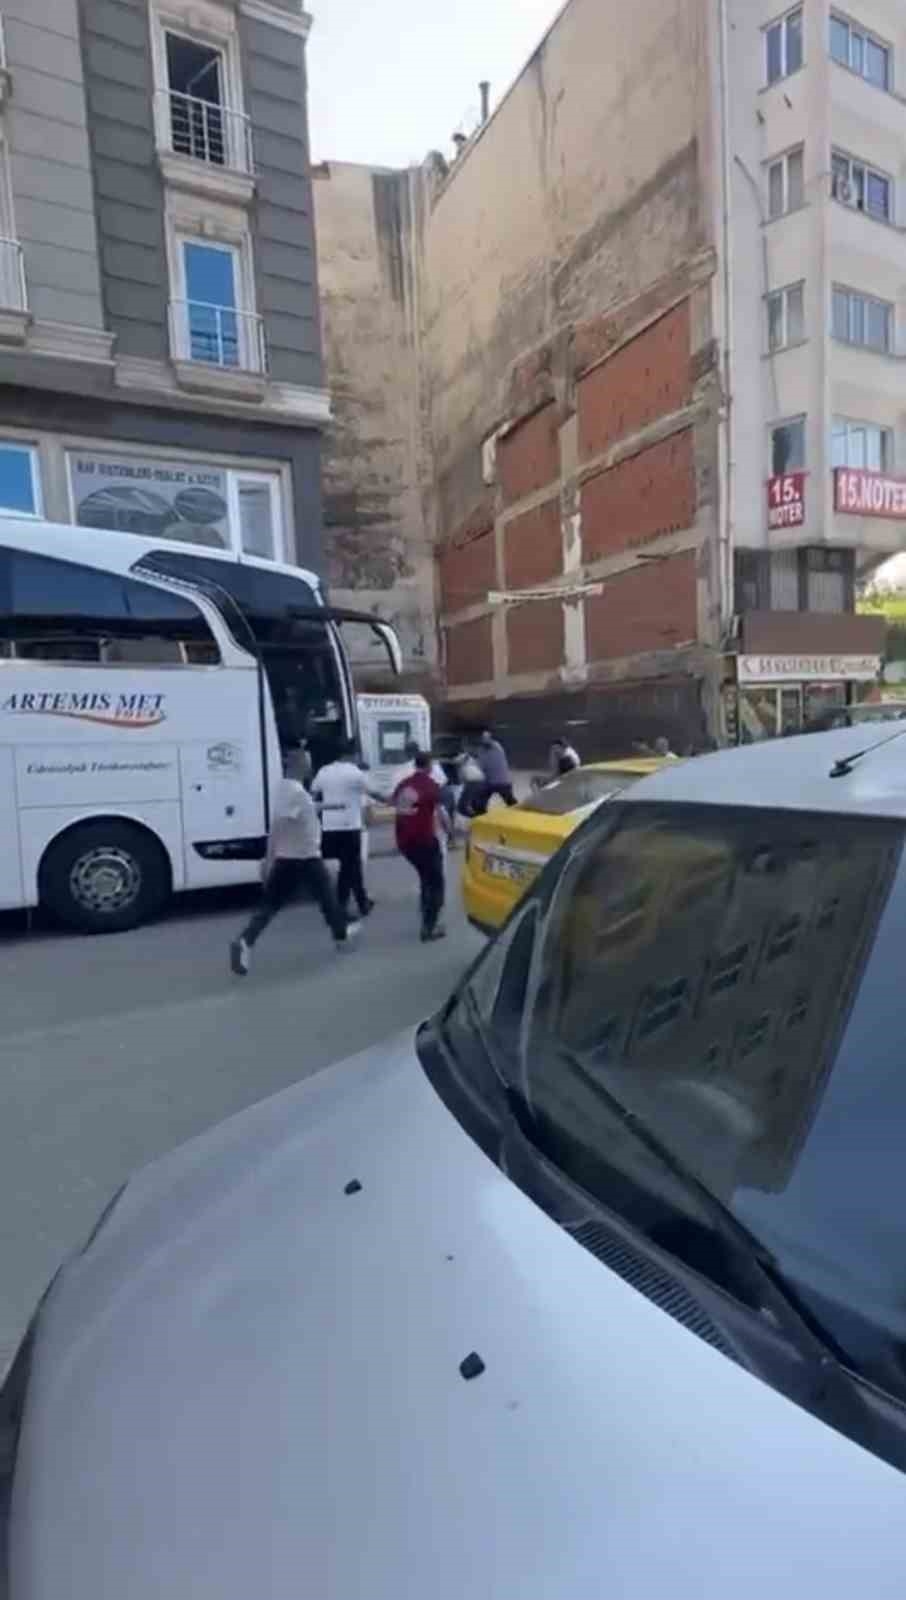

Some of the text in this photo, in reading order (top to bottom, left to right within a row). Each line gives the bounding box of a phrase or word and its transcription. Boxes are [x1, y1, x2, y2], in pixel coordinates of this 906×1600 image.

[772, 478, 800, 503] 15.
[838, 472, 906, 512] 15.NOTE
[4, 693, 111, 710] ARTEMIS
